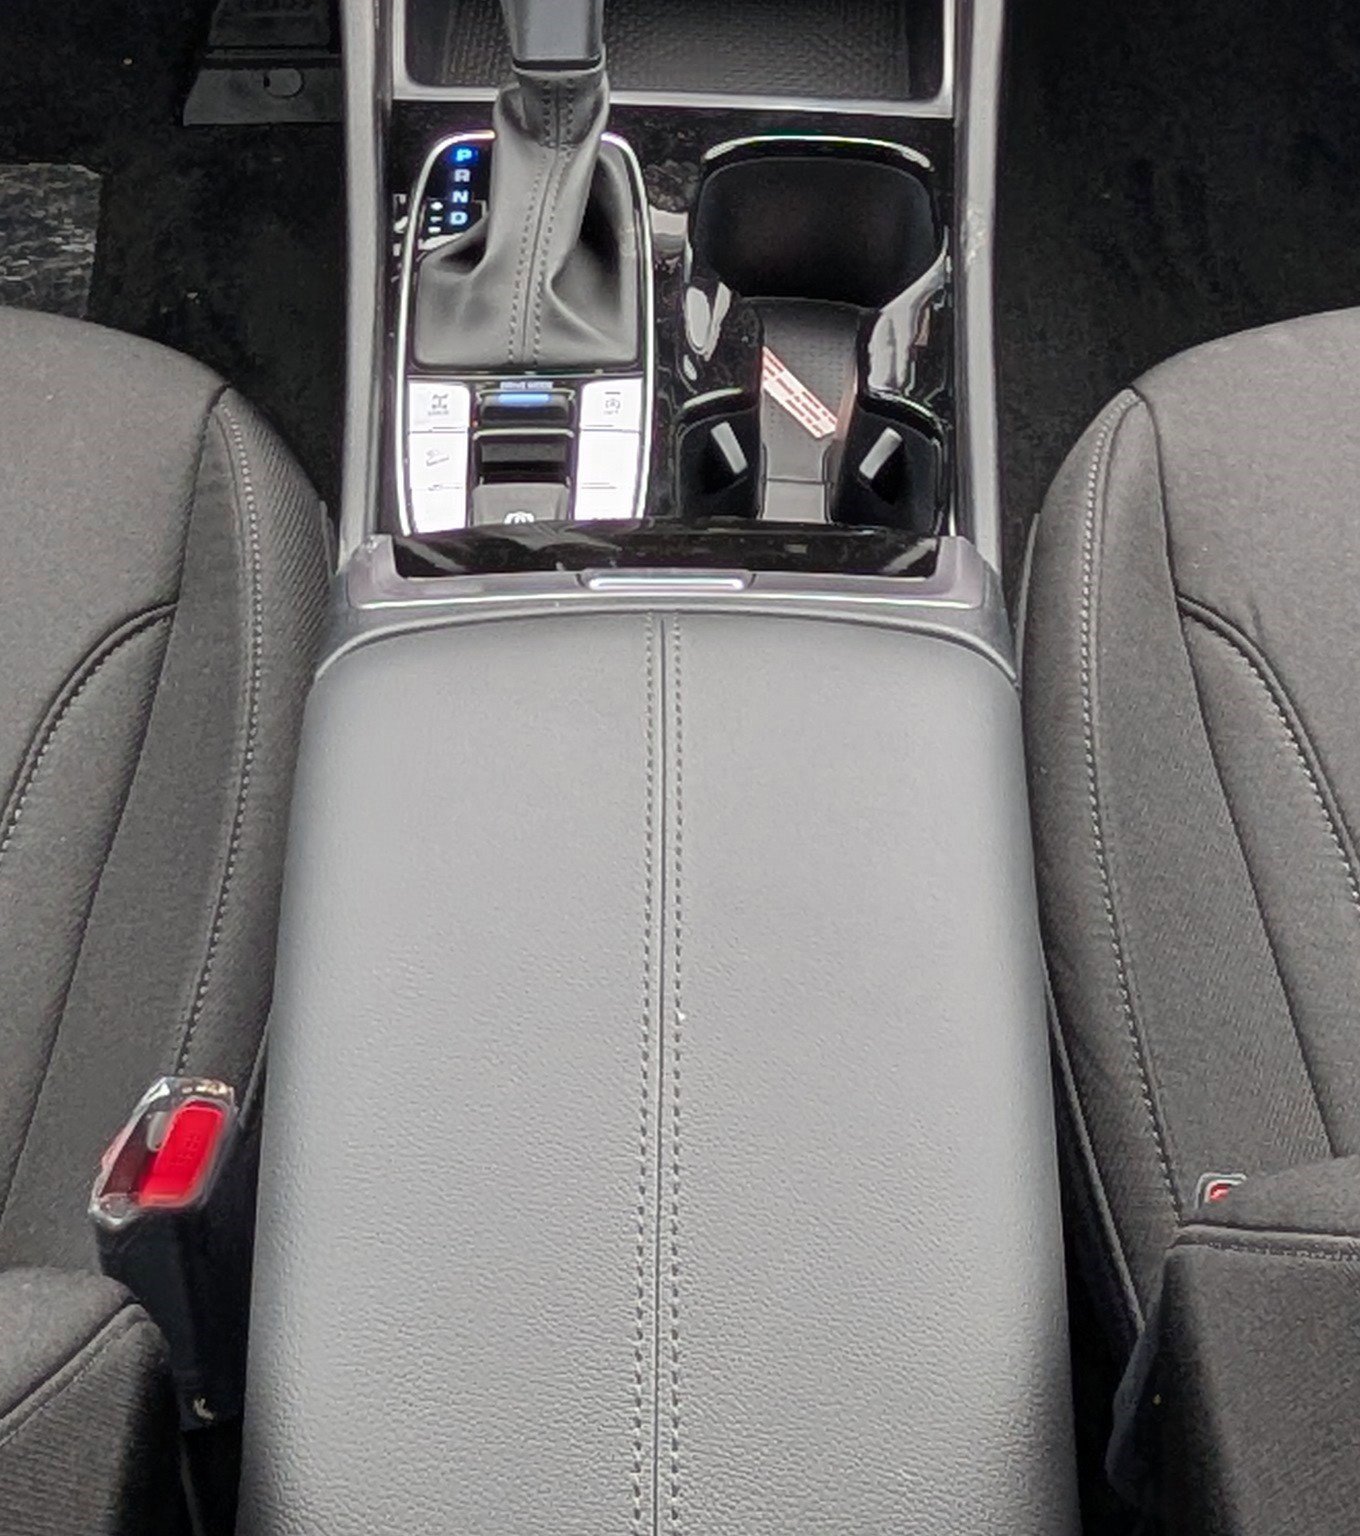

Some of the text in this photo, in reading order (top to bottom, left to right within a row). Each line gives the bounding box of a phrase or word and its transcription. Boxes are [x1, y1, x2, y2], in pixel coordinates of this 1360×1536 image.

[455, 148, 472, 162] P
[452, 190, 468, 203] N
[450, 211, 468, 225] D
